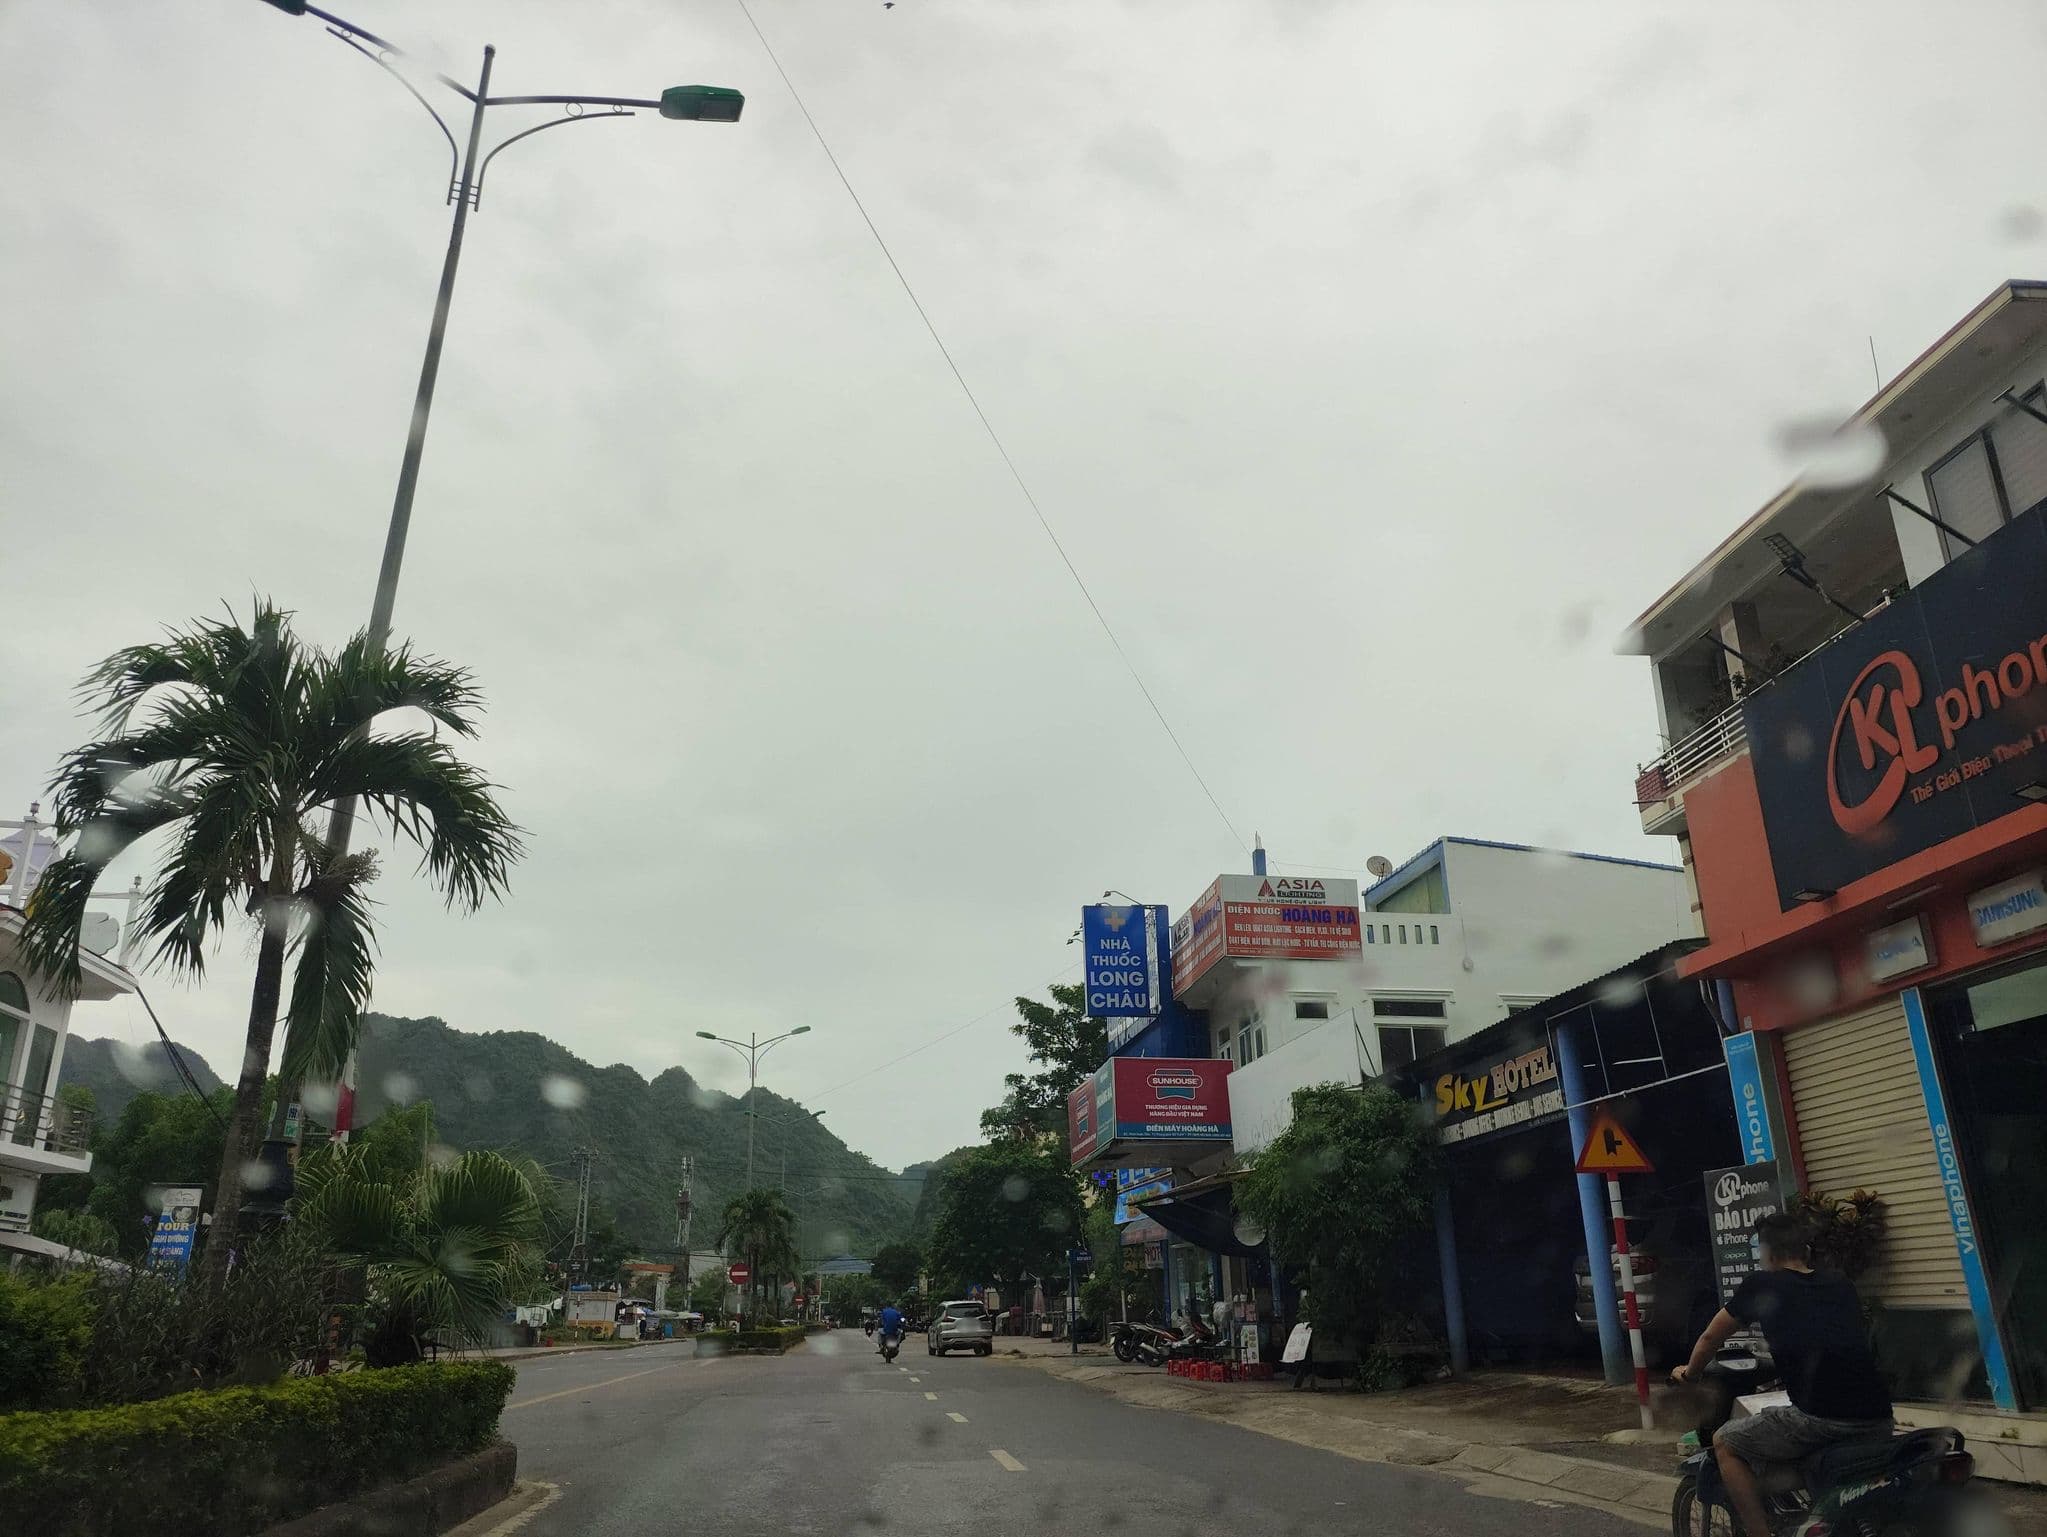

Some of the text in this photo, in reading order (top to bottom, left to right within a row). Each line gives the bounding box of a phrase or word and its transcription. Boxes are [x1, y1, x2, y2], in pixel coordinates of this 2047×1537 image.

[1911, 777, 1933, 804] Thế
[1936, 767, 1962, 792] Giới
[1962, 755, 1992, 780] Điện
[1277, 879, 1325, 890] ASIA
[1227, 904, 1251, 916] ĐIỆN
[1282, 905, 1332, 923] HOÀNG
[1336, 906, 1357, 925] HÀ
[1100, 936, 1131, 950] NHÀ
[1092, 951, 1142, 966] THUỐC
[1090, 971, 1145, 986] LONG
[1090, 989, 1146, 1008] CHÂU
[1490, 1046, 1558, 1098] HOTEL
[1152, 1077, 1198, 1085] SUNHOUSE
[1208, 1124, 1219, 1132] HÀ
[1740, 1180, 1769, 1198] phone
[1935, 1123, 1974, 1254] vinaphone
[158, 1222, 188, 1231] TOUR
[1724, 1233, 1748, 1244] iPhone
